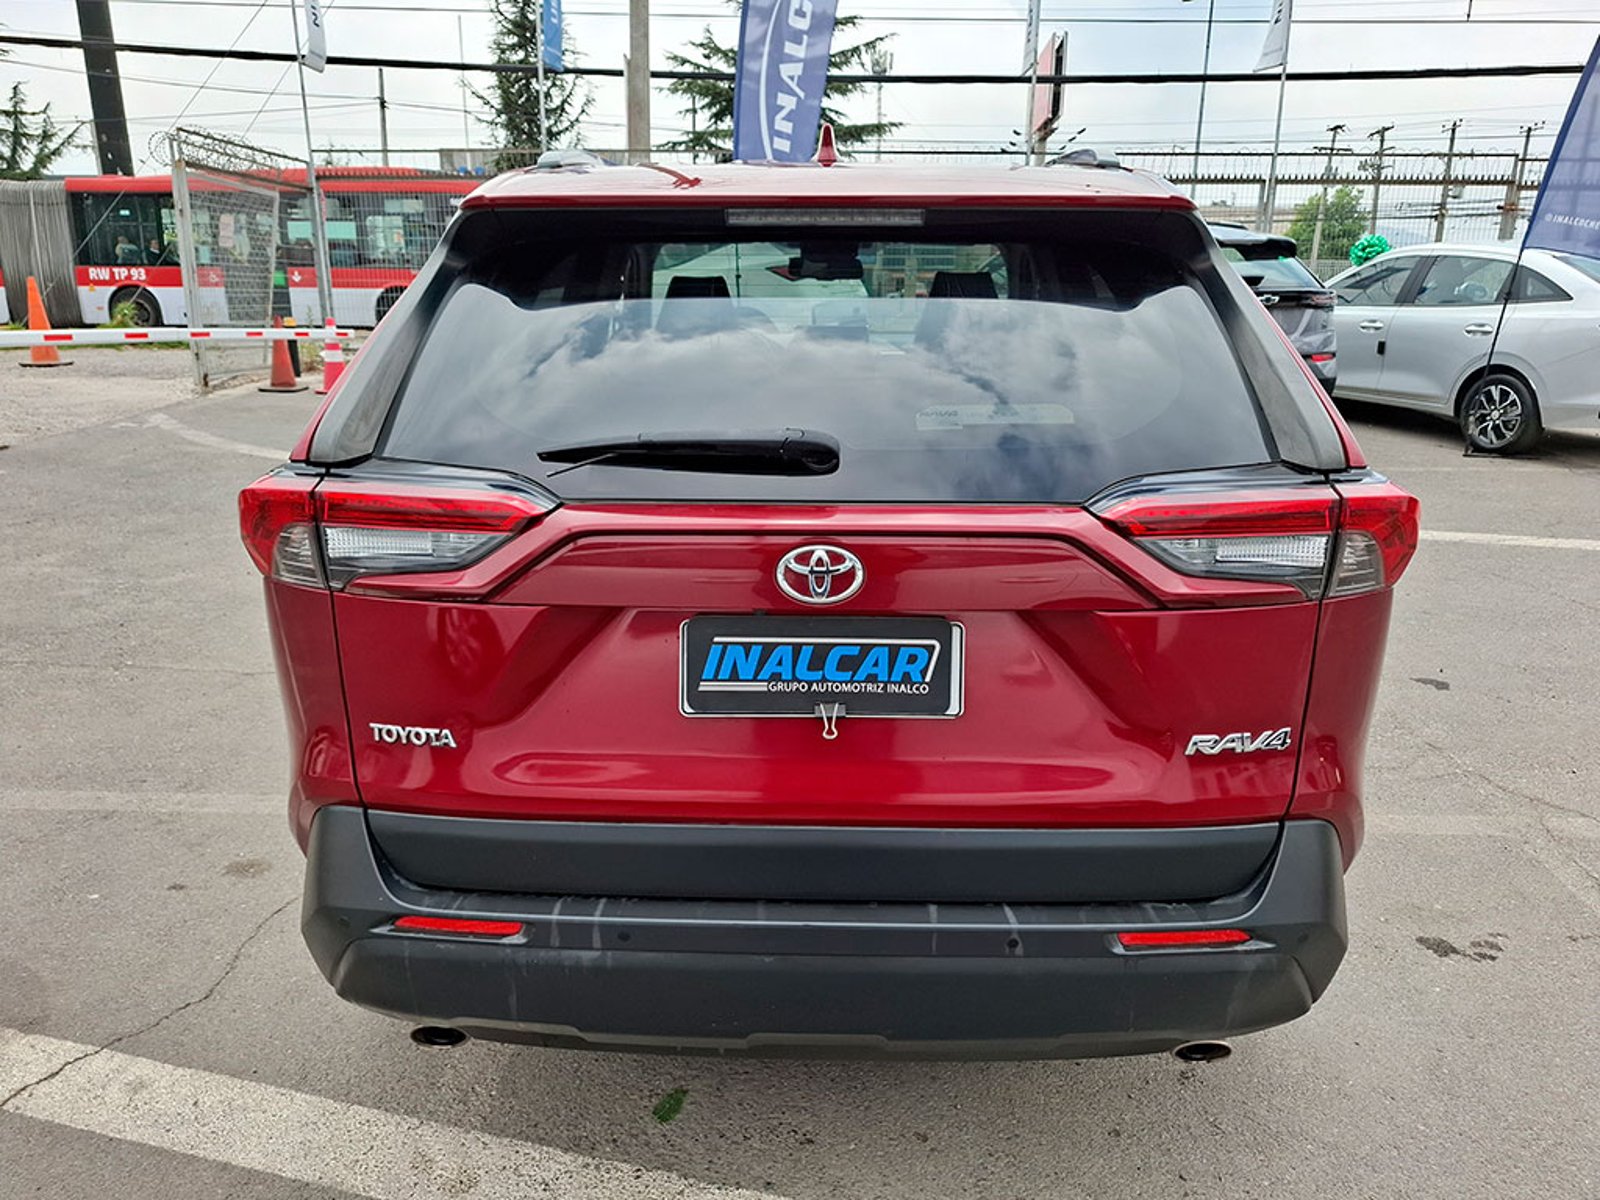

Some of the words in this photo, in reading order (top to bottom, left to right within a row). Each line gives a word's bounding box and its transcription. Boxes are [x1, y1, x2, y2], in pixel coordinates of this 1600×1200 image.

[88, 267, 110, 280] RW
[112, 267, 128, 280] TP
[130, 267, 146, 280] 93
[701, 644, 929, 683] INALCAR
[768, 681, 809, 693] GRUPO
[810, 682, 884, 694] AUTOMOTRIZ
[886, 683, 930, 695] INALCO
[369, 722, 457, 748] TOYOTA
[1184, 726, 1292, 756] RAV4
